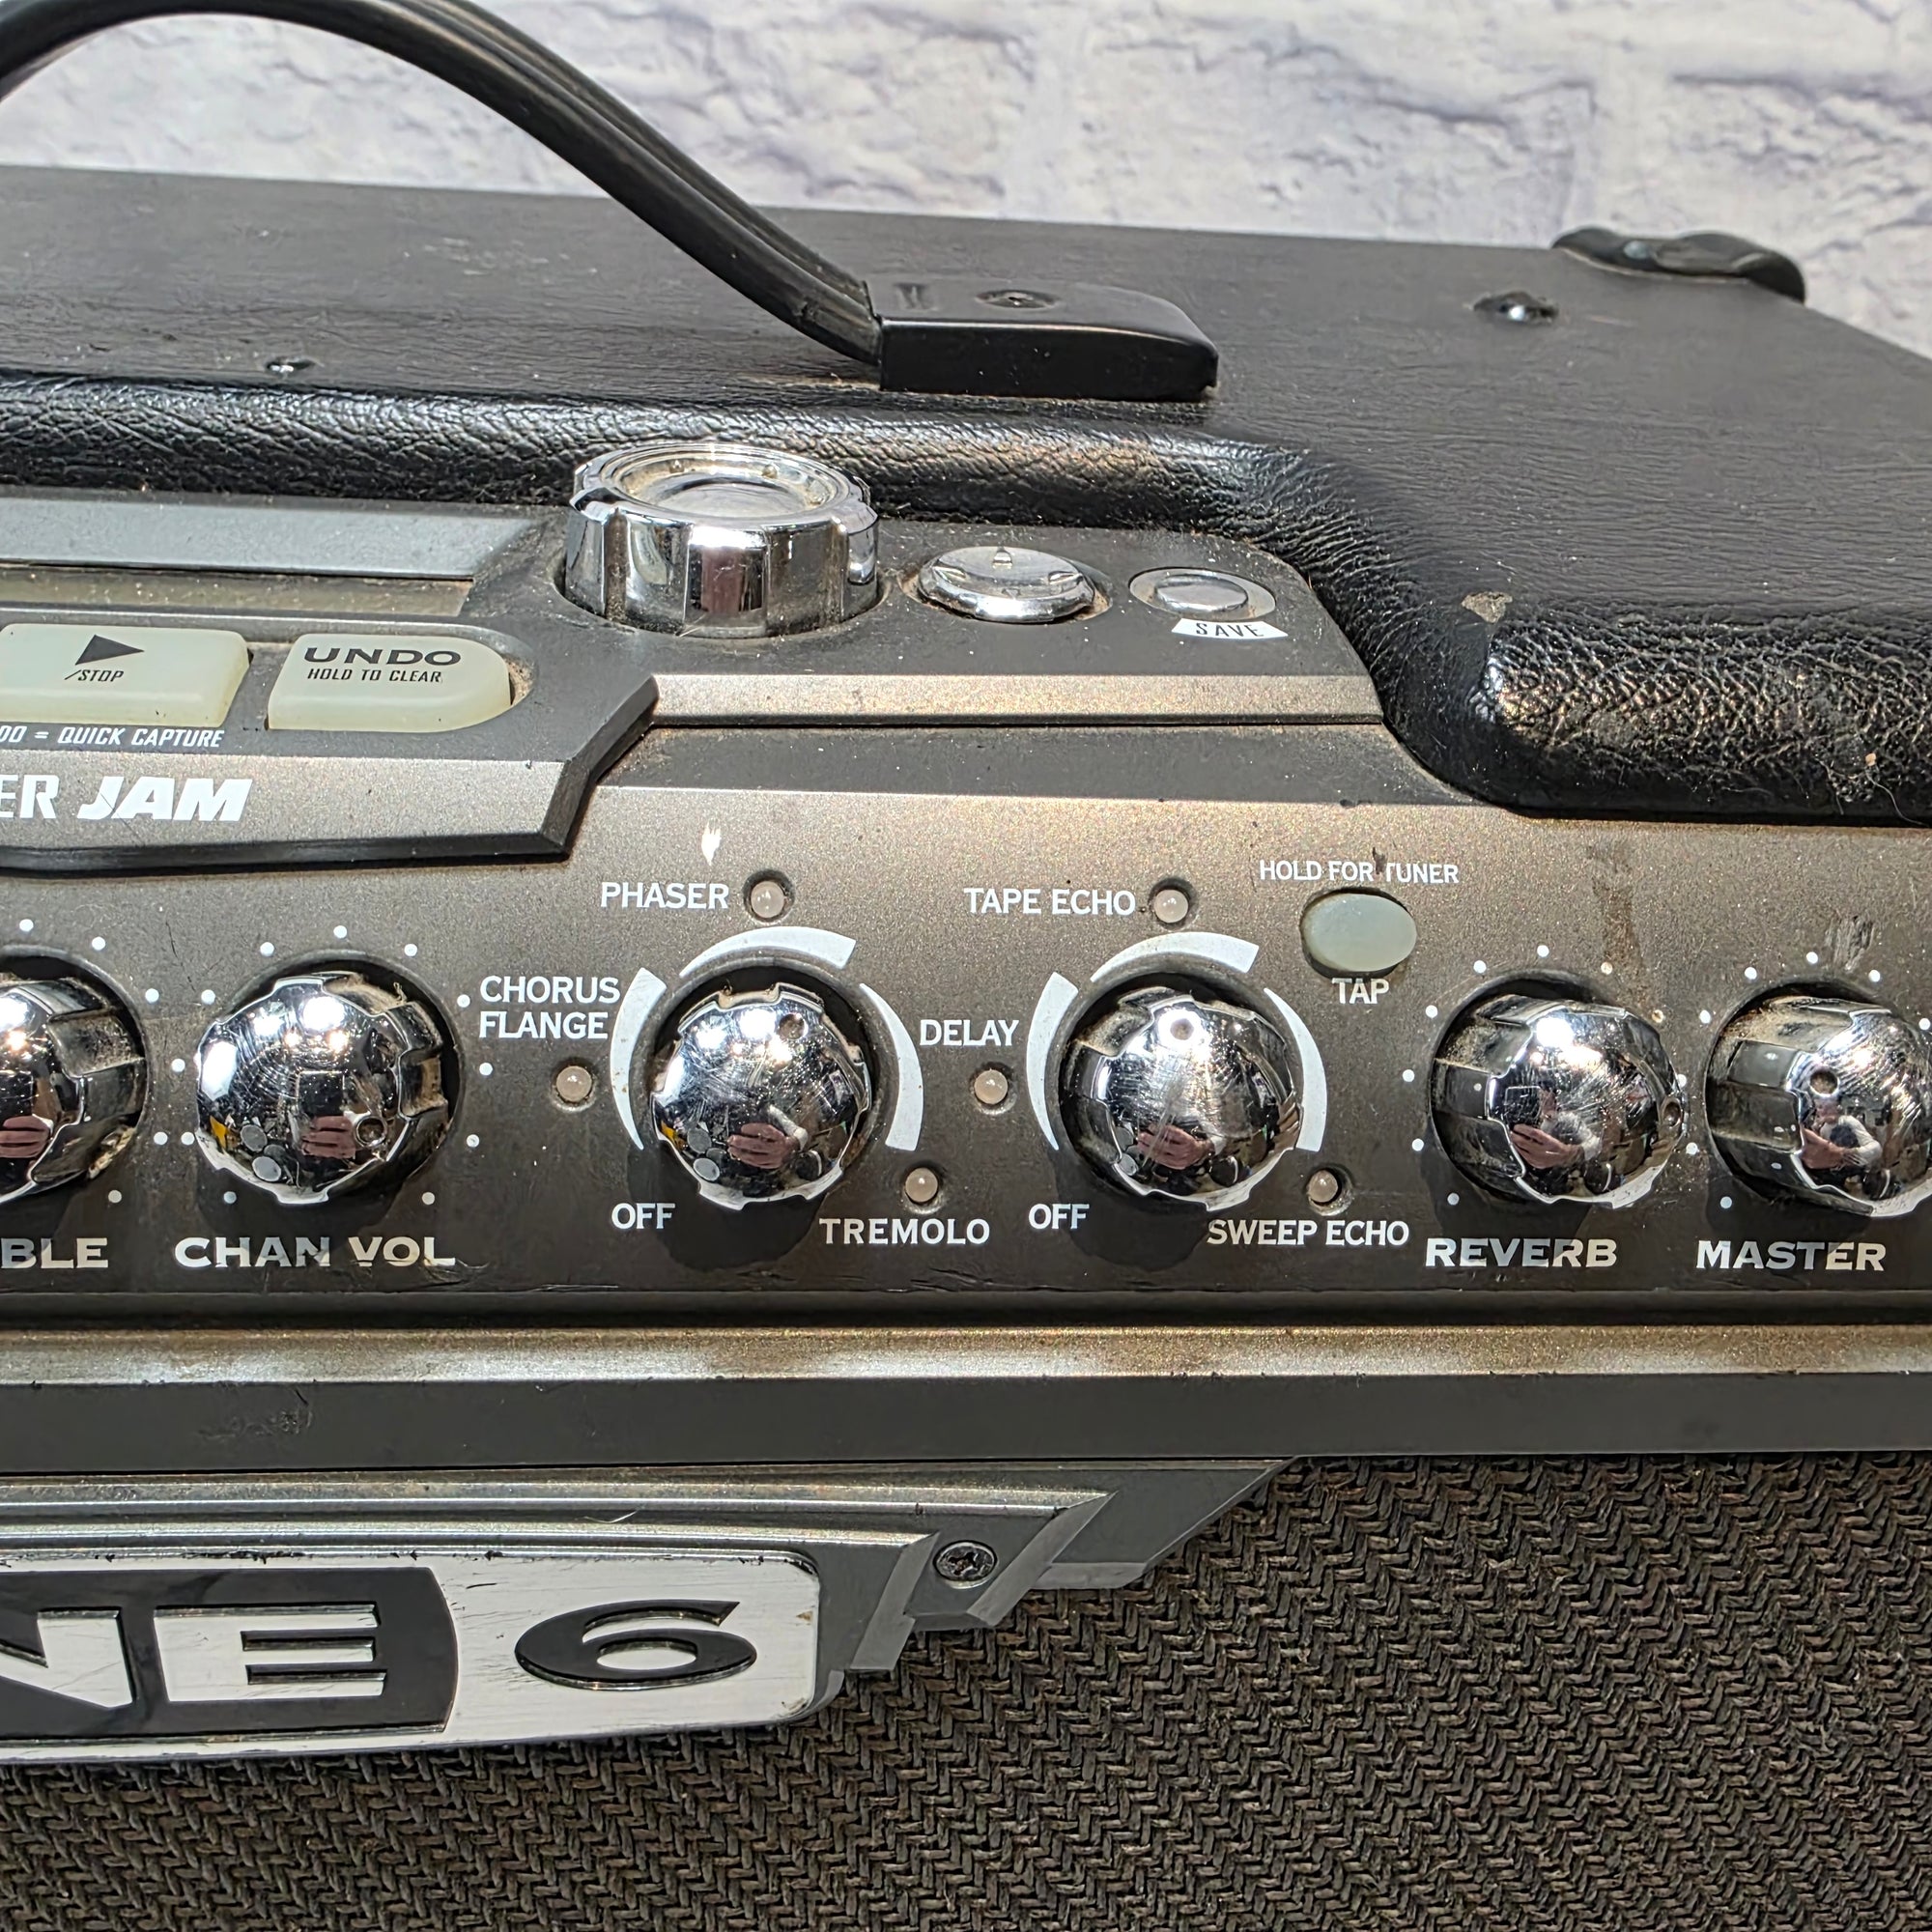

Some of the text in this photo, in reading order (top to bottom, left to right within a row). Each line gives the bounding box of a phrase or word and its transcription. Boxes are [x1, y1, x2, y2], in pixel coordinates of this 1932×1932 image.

[1196, 623, 1264, 637] SAVE
[304, 647, 462, 666] UNDO
[307, 668, 441, 683] HOLD TO CLEAR
[57, 726, 126, 746] QUICK
[130, 728, 225, 748] CAPTURE
[76, 776, 253, 822] JAM
[1260, 860, 1460, 884] HOLD FOR TUNER
[600, 882, 729, 910] PHASER
[964, 888, 1136, 917] TAPE ECHO
[479, 975, 620, 1005] CHORUS
[1331, 978, 1390, 1005] TAP
[479, 1011, 609, 1039] FLANGE
[920, 1019, 1019, 1047] DELAY
[611, 1203, 676, 1230] OFF
[1029, 1203, 1090, 1230] OFF
[819, 1217, 990, 1245] TREMOLO
[1208, 1220, 1409, 1245] SWEEP ECHO
[0, 1237, 109, 1268] BLE
[174, 1236, 456, 1268] CHAN VOL
[1425, 1238, 1617, 1268] REVERB
[1696, 1240, 1886, 1271] MASTER
[515, 1600, 757, 1690] 6
